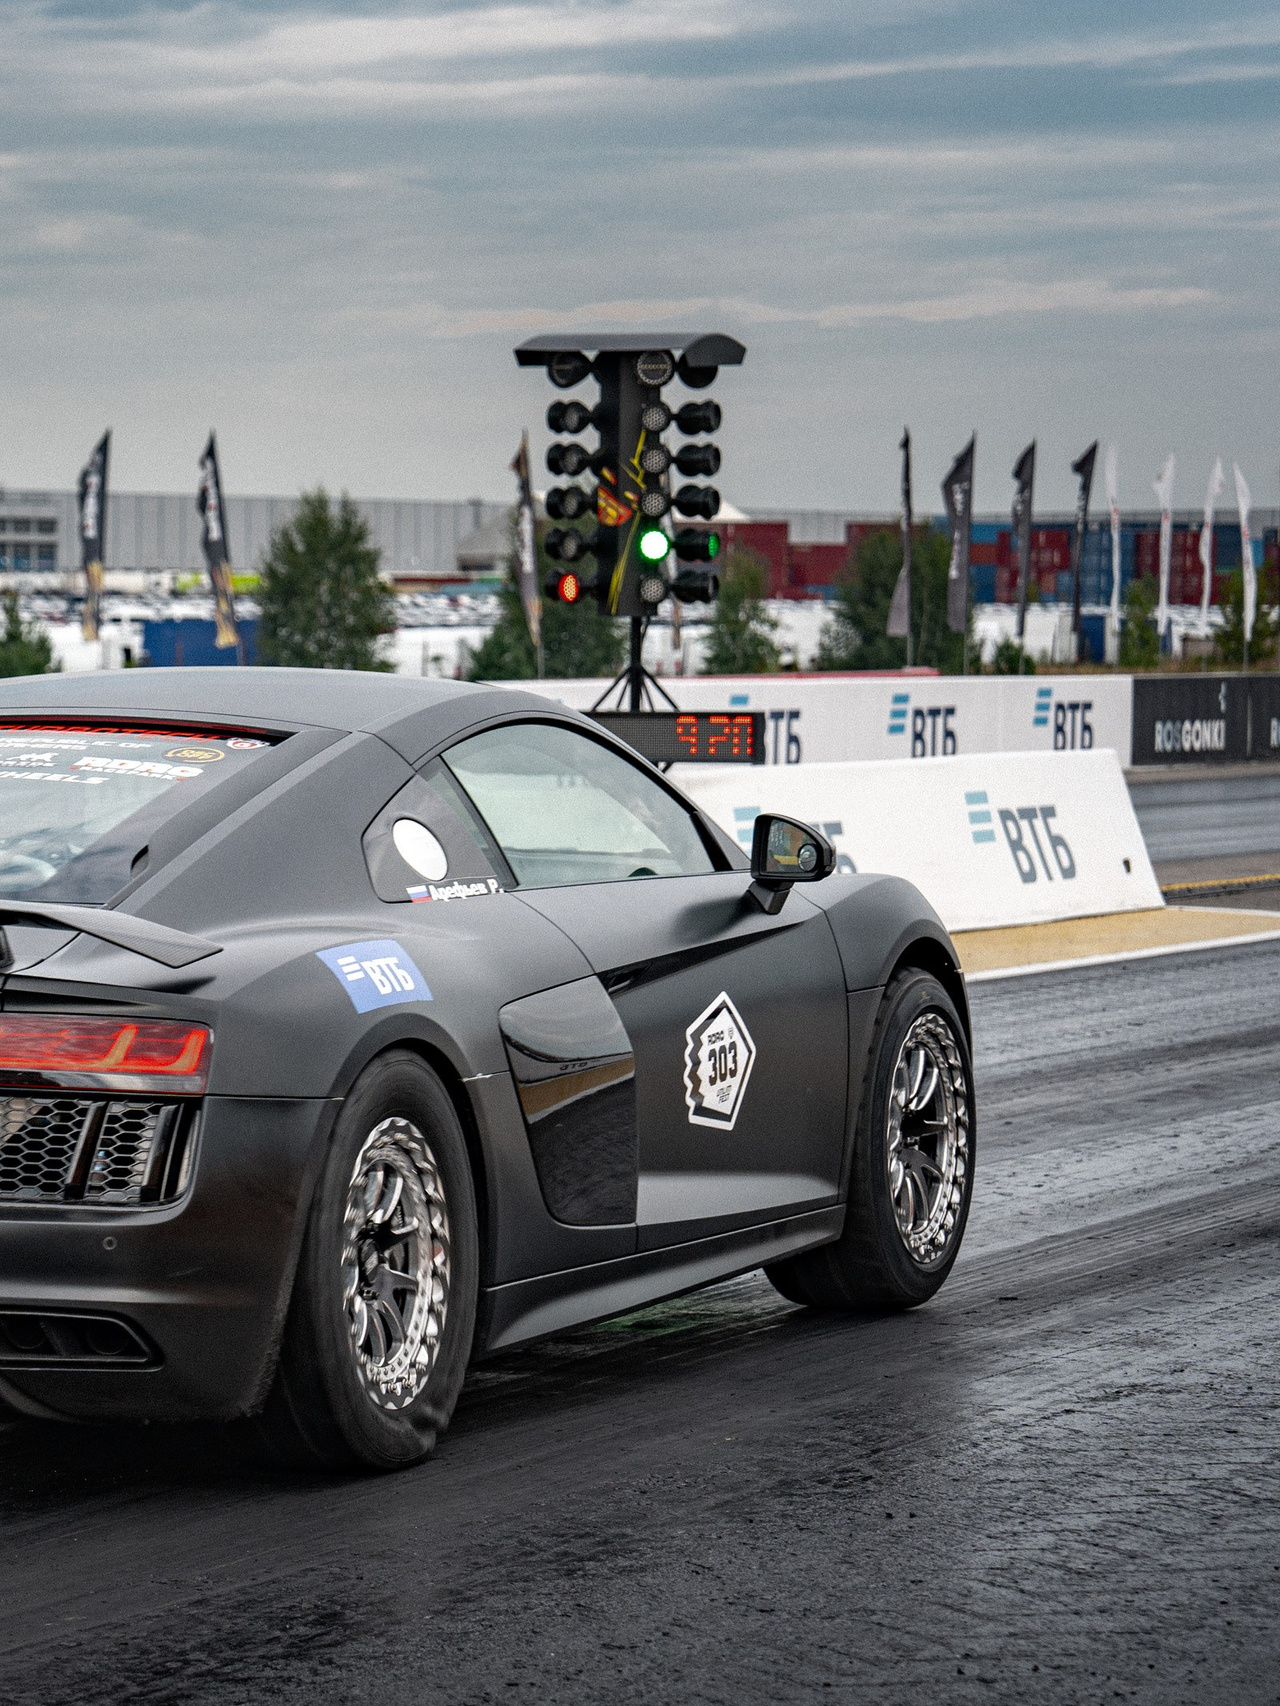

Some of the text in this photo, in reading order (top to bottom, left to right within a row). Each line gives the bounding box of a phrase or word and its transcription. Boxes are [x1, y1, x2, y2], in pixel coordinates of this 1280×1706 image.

[768, 710, 800, 764] ТБ
[911, 706, 956, 758] ВТБ
[1054, 701, 1093, 750] ВТБ
[1154, 719, 1225, 753] ROSGONKI
[73, 756, 204, 778] RDRC
[998, 805, 1076, 883] ВТБ
[361, 956, 415, 995] ВТБ
[708, 1041, 738, 1087] 303
